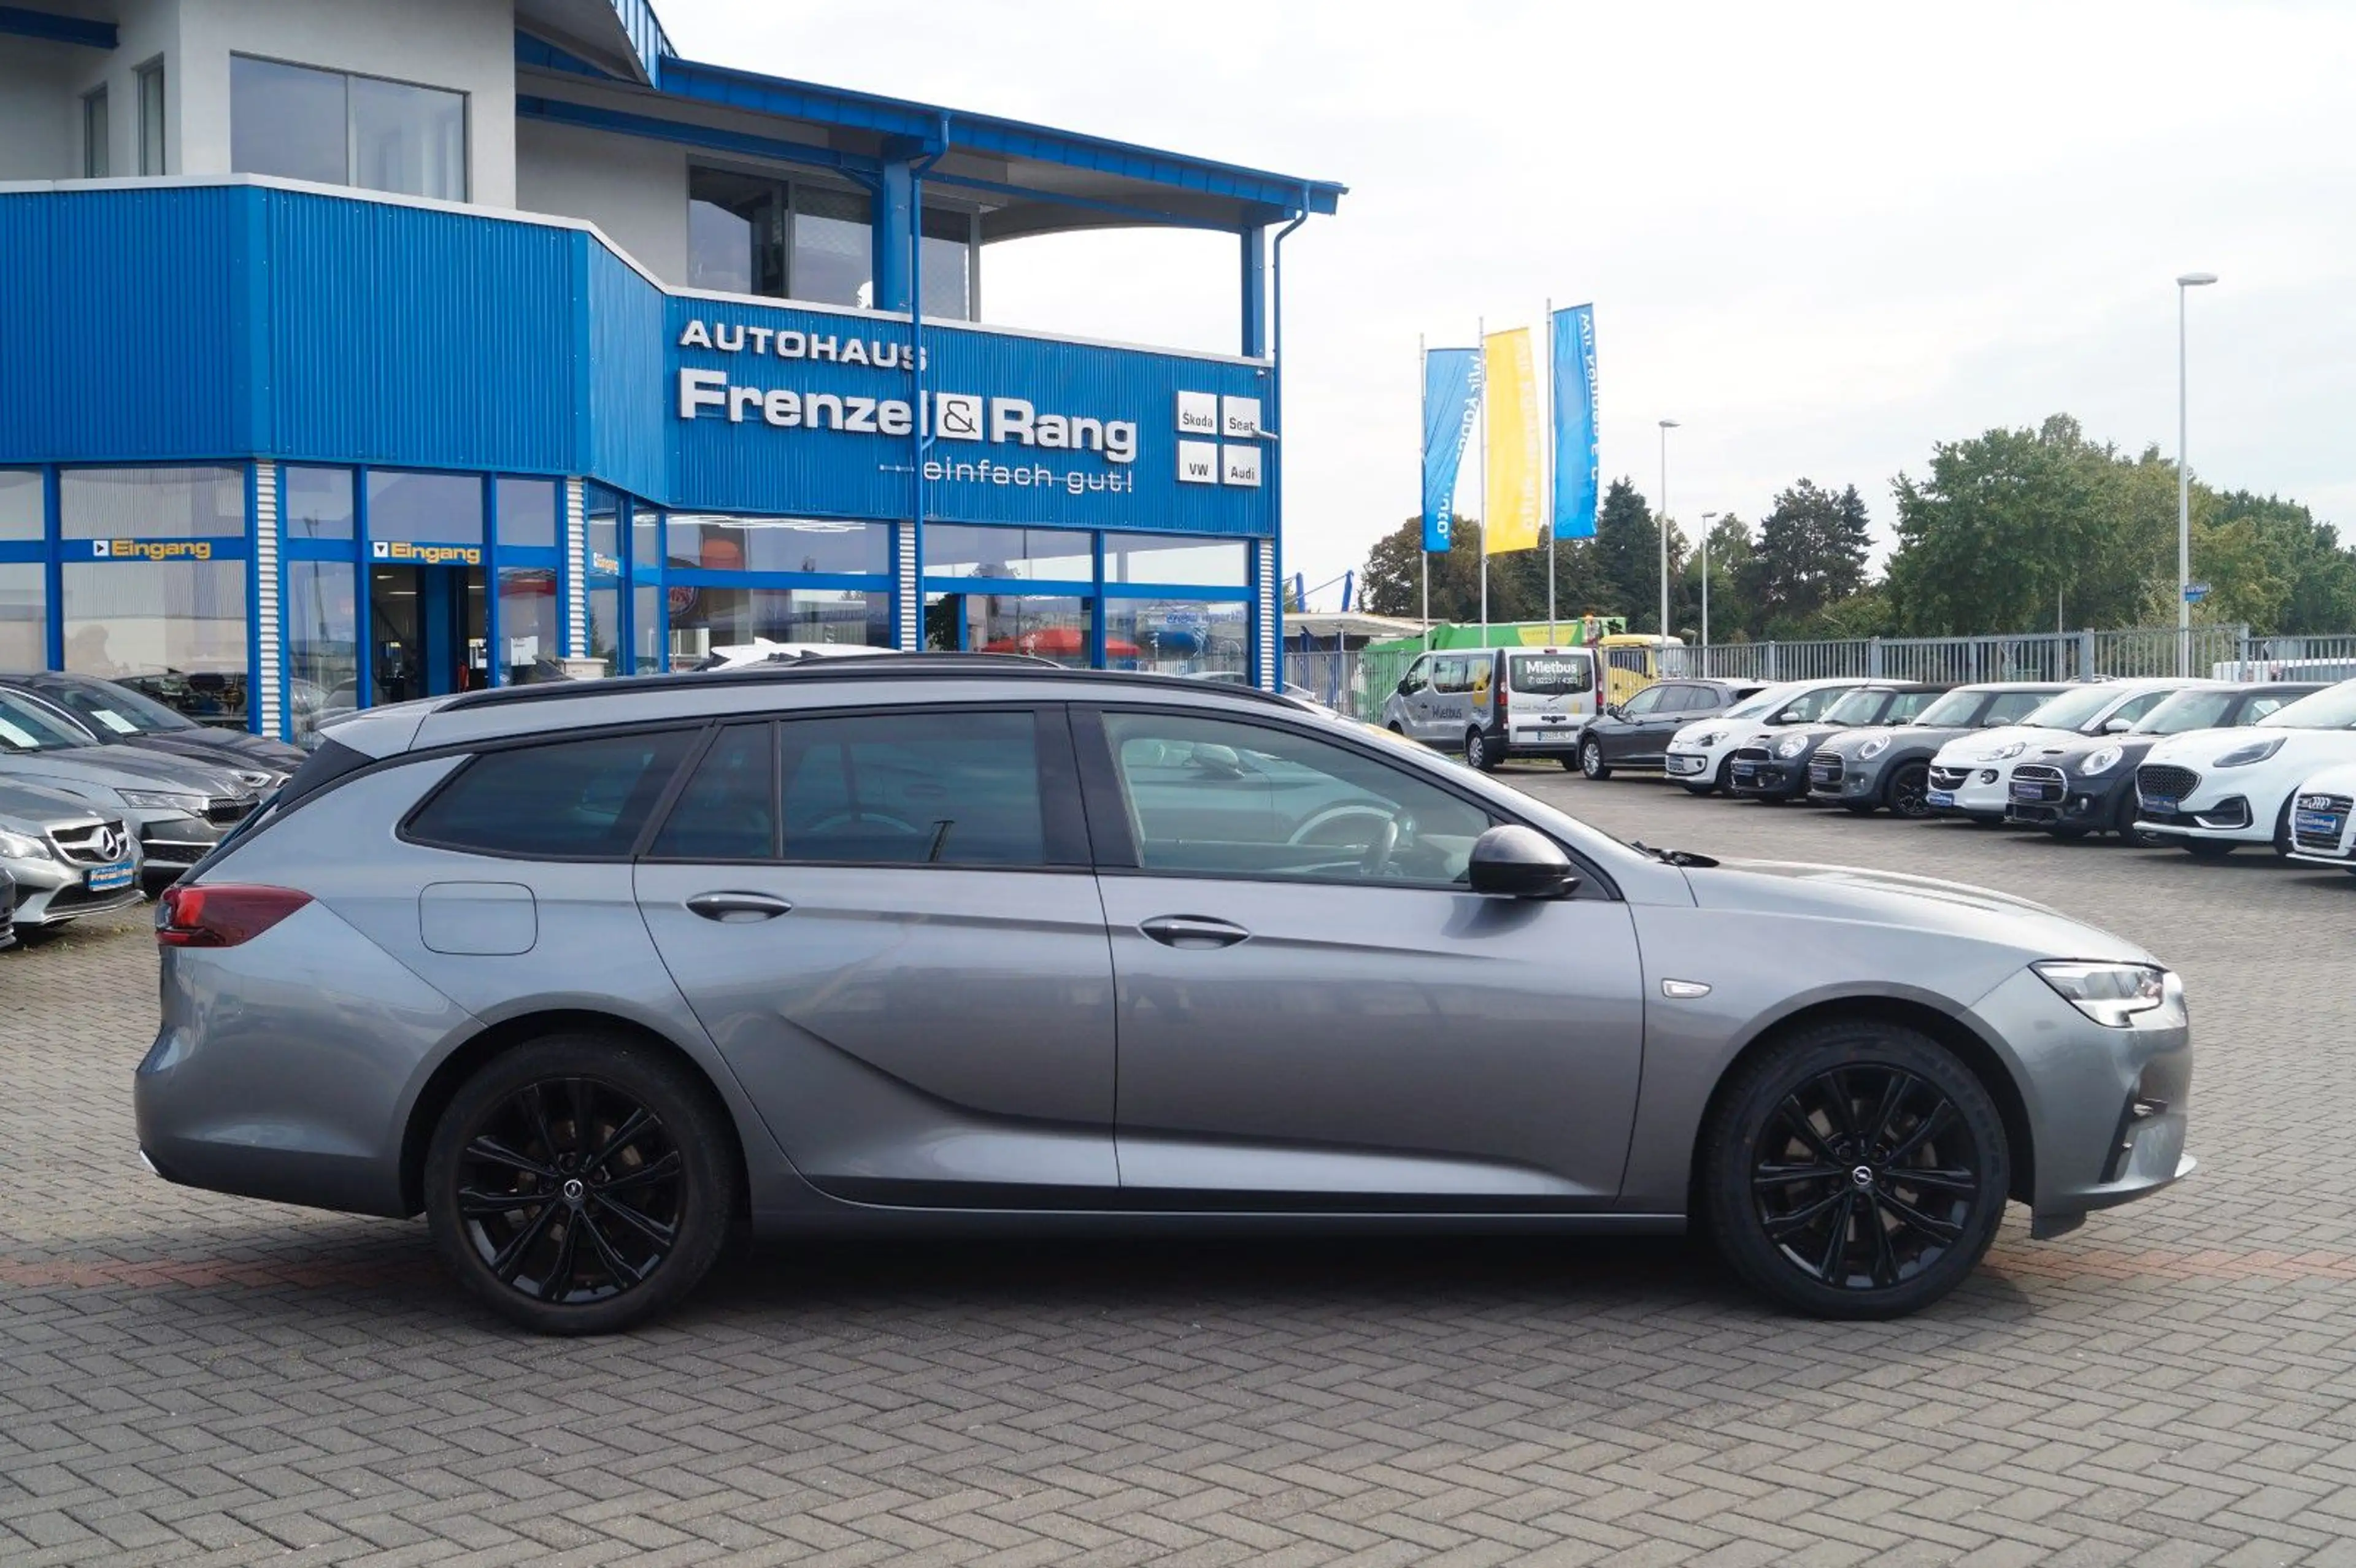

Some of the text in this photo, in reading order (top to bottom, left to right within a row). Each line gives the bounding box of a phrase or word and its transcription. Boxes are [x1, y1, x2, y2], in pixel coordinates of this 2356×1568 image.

[679, 320, 927, 371] AUTOHAUS
[680, 367, 1136, 463] Frenzel & Rang
[1229, 417, 1255, 432] Seat
[923, 456, 1133, 494] einfach gut!
[1189, 463, 1209, 477] VW
[1230, 466, 1255, 480] Audi
[112, 540, 212, 561] Eingang
[391, 542, 481, 564] Eingang
[1525, 661, 1578, 674] Mietbus
